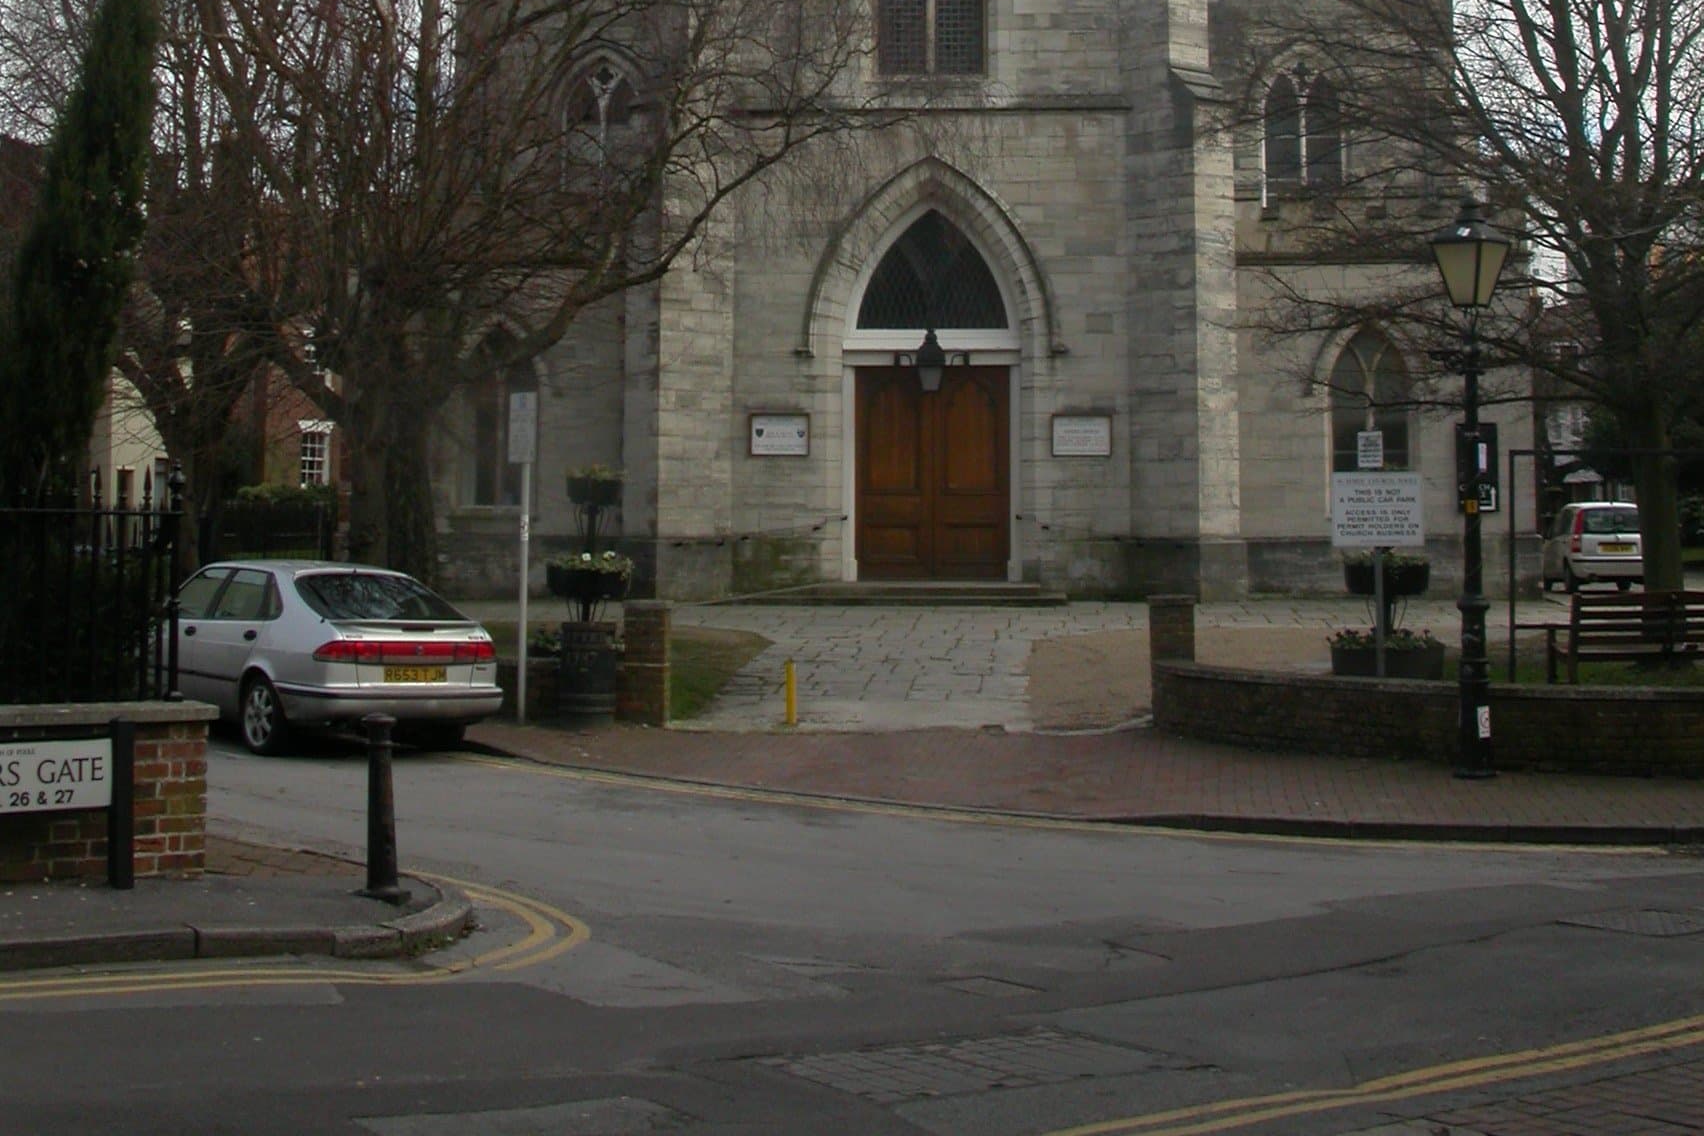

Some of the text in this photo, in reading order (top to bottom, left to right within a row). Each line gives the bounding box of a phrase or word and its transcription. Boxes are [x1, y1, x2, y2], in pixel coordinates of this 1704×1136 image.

[37, 756, 104, 784] GATE
[10, 789, 74, 807] 26 & 27
